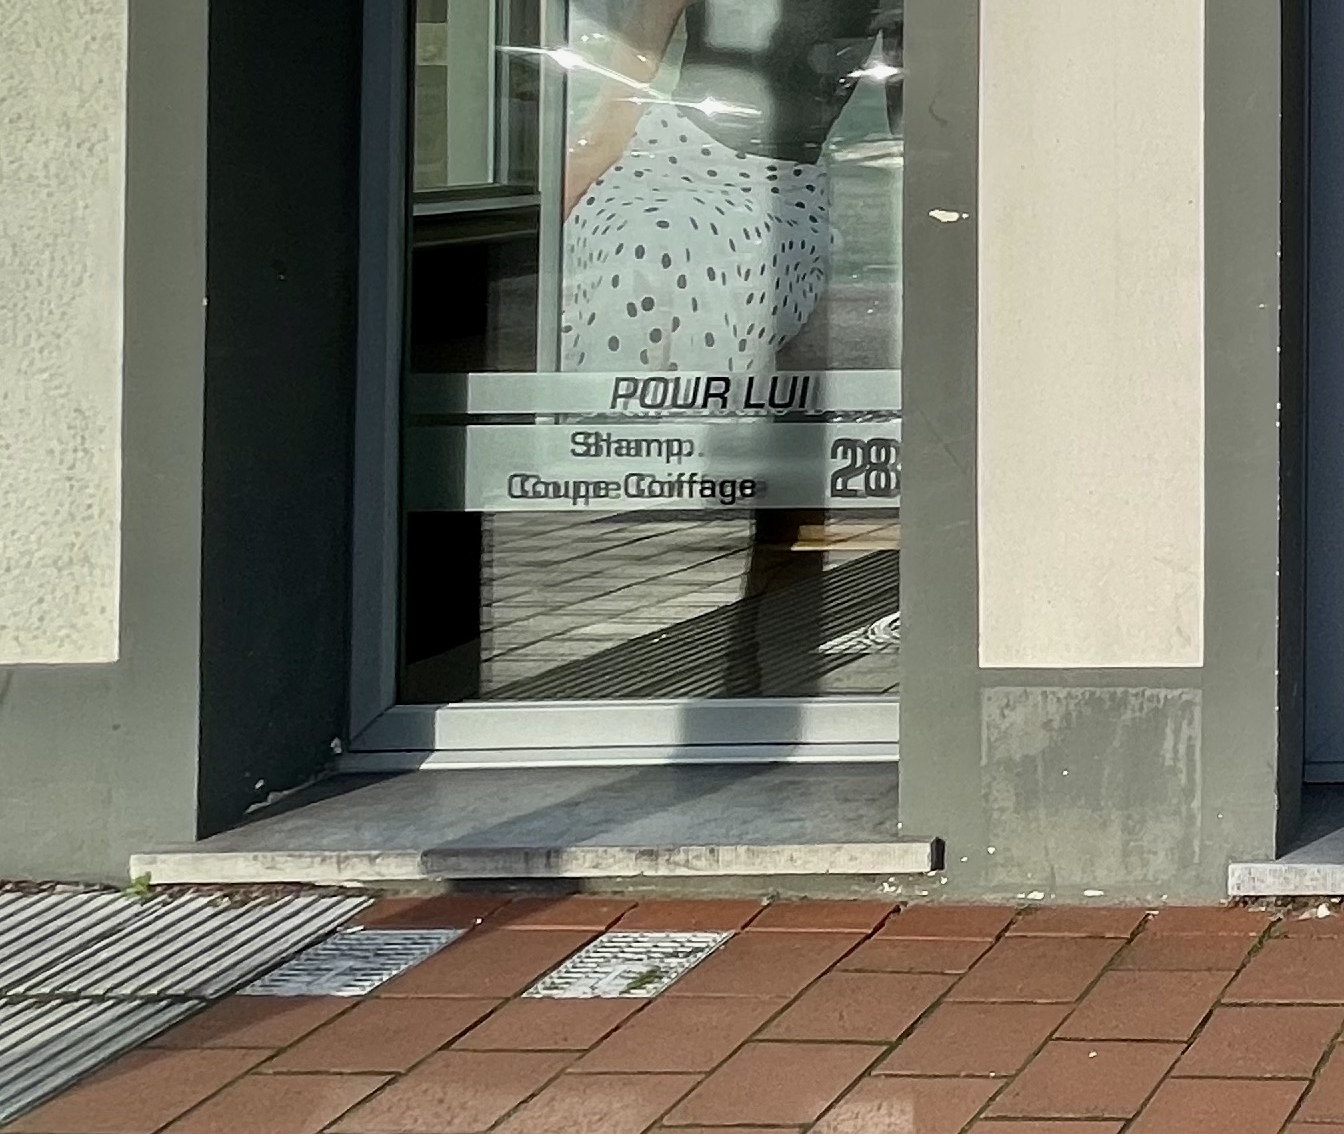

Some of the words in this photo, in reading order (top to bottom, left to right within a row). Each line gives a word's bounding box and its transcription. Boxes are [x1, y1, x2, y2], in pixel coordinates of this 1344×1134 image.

[610, 376, 732, 410] POUR
[744, 376, 810, 410] LUI
[507, 472, 612, 506] Coupe
[624, 472, 758, 506] Coiffage
